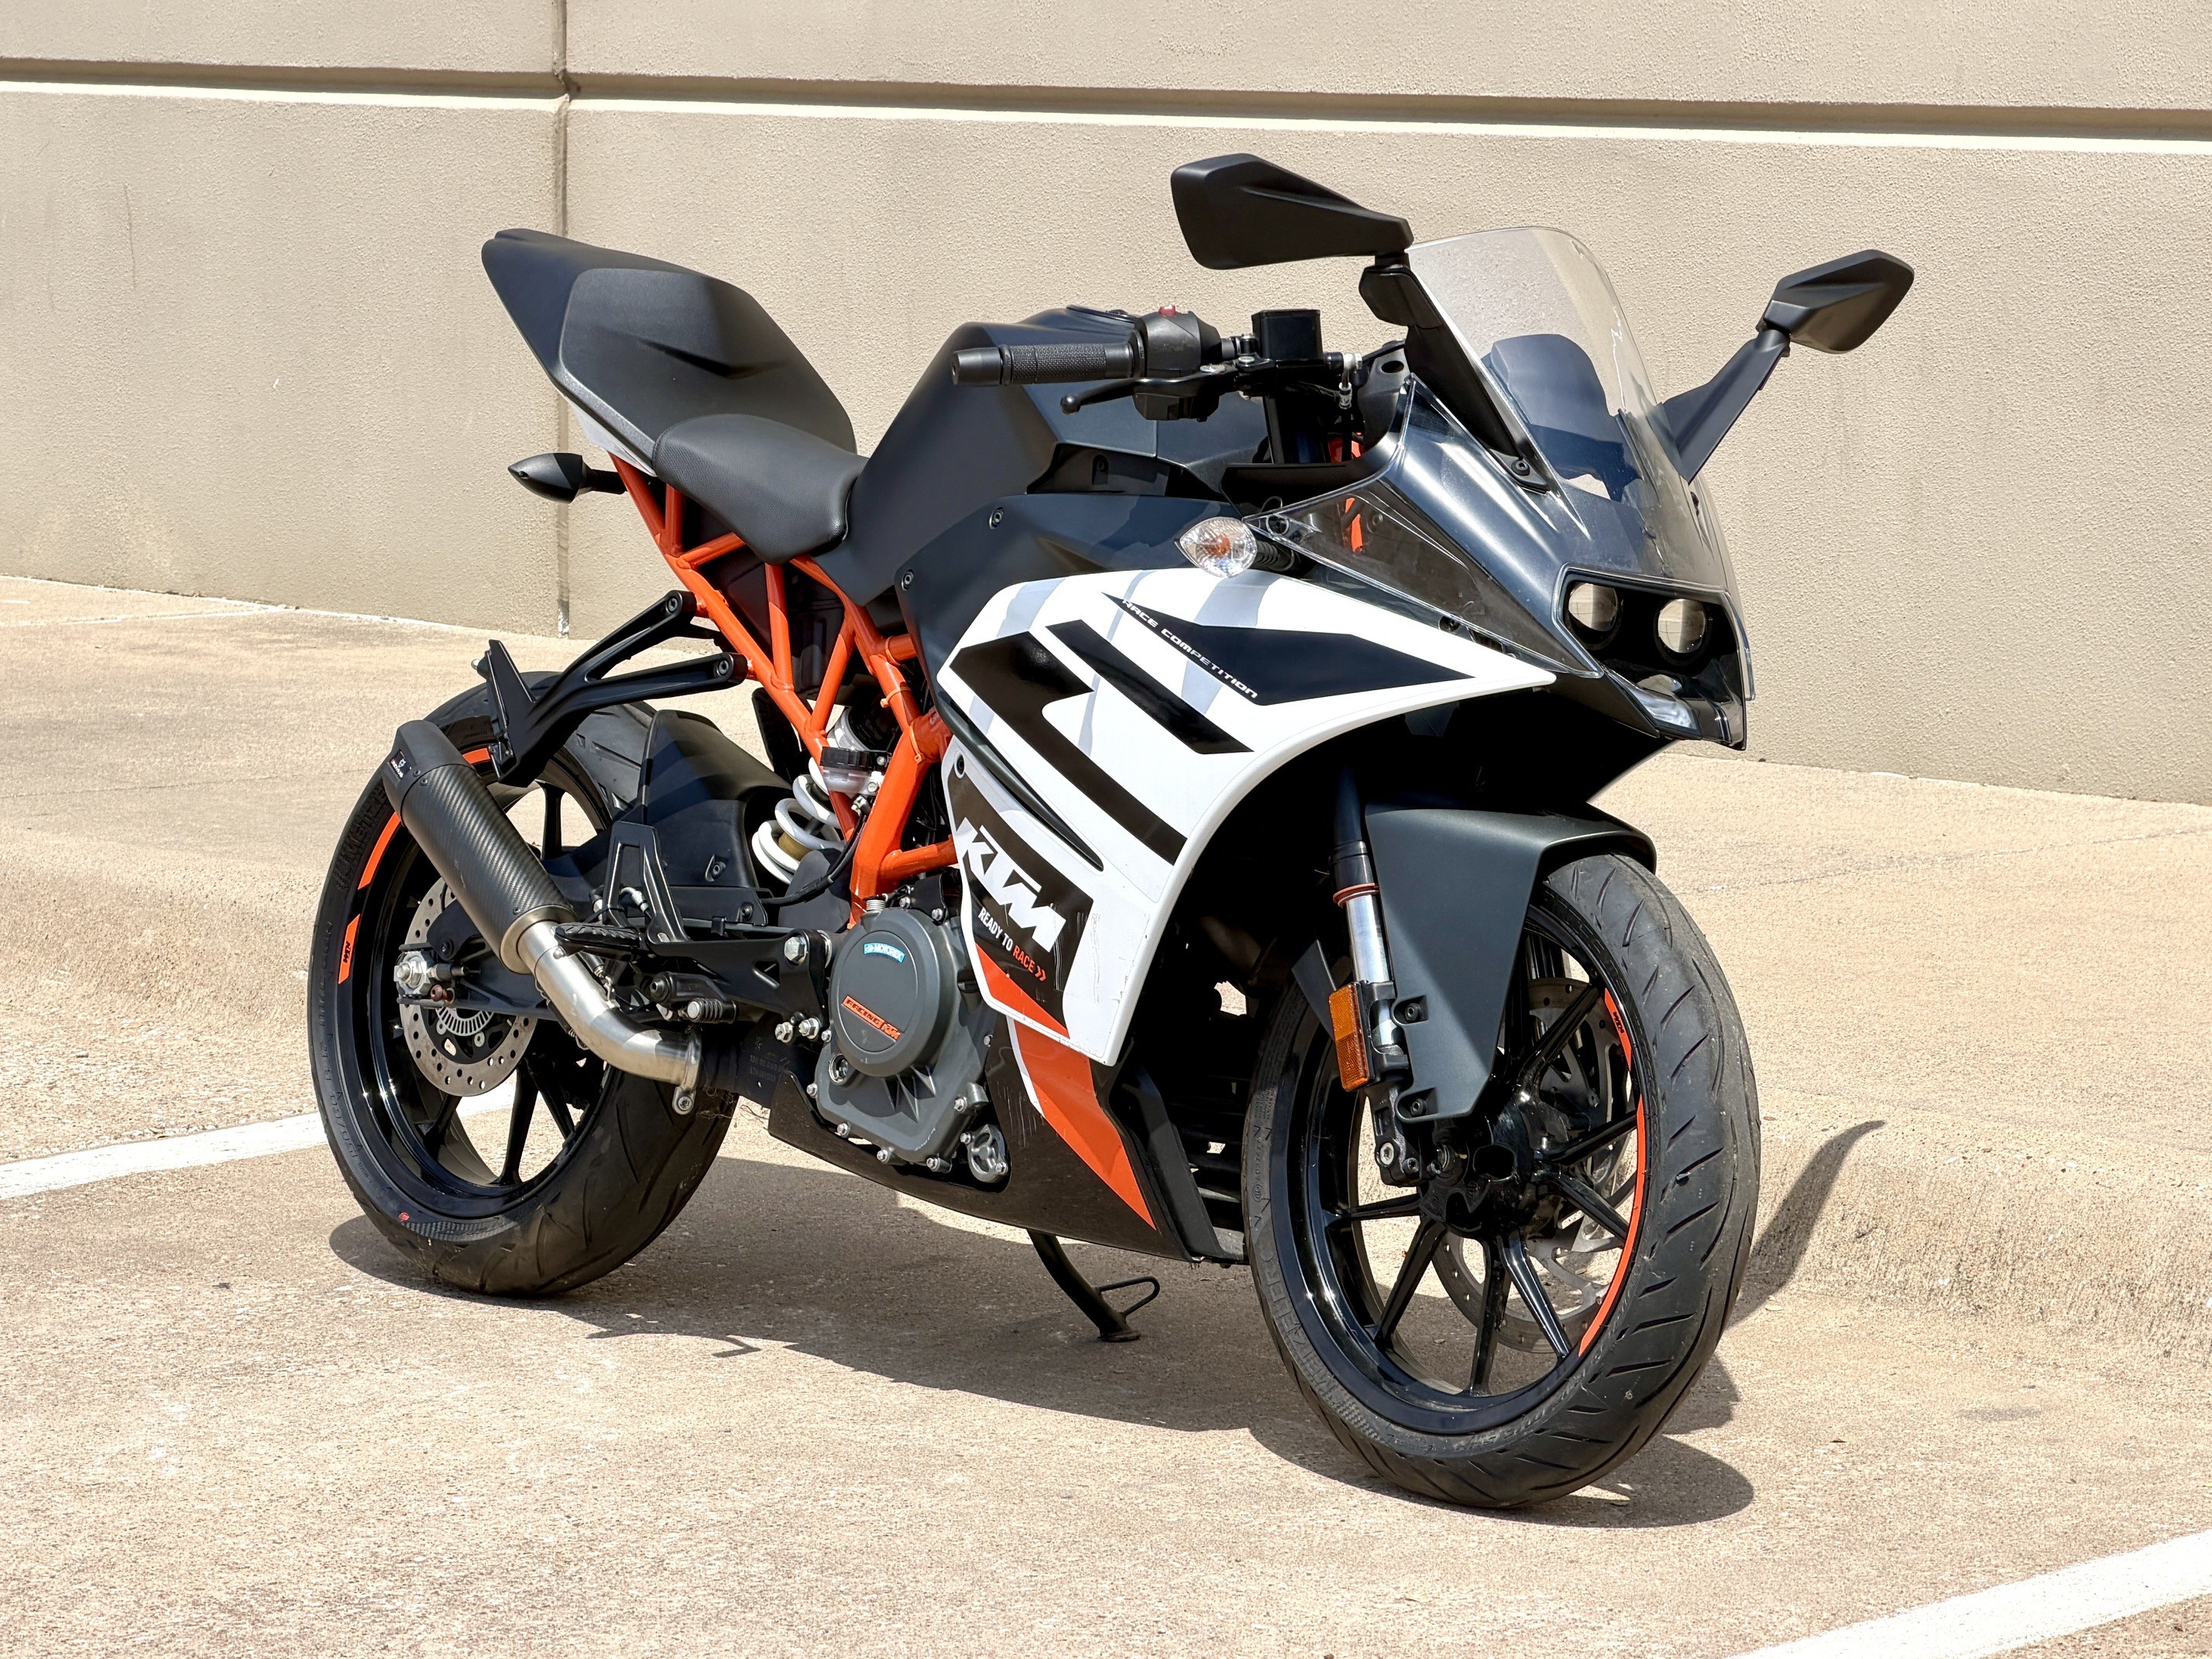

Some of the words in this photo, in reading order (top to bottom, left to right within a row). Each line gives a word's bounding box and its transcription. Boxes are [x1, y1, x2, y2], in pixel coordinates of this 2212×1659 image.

[1121, 599, 1159, 628] RACE
[1161, 628, 1259, 699] COMPETITION
[956, 816, 1066, 953] KTM
[874, 943, 903, 960] MOTOREX
[977, 906, 1003, 939] READY
[1001, 933, 1014, 952] TO
[1012, 945, 1034, 974] RACE
[846, 998, 881, 1025] RACING
[881, 1023, 901, 1039] KTM
